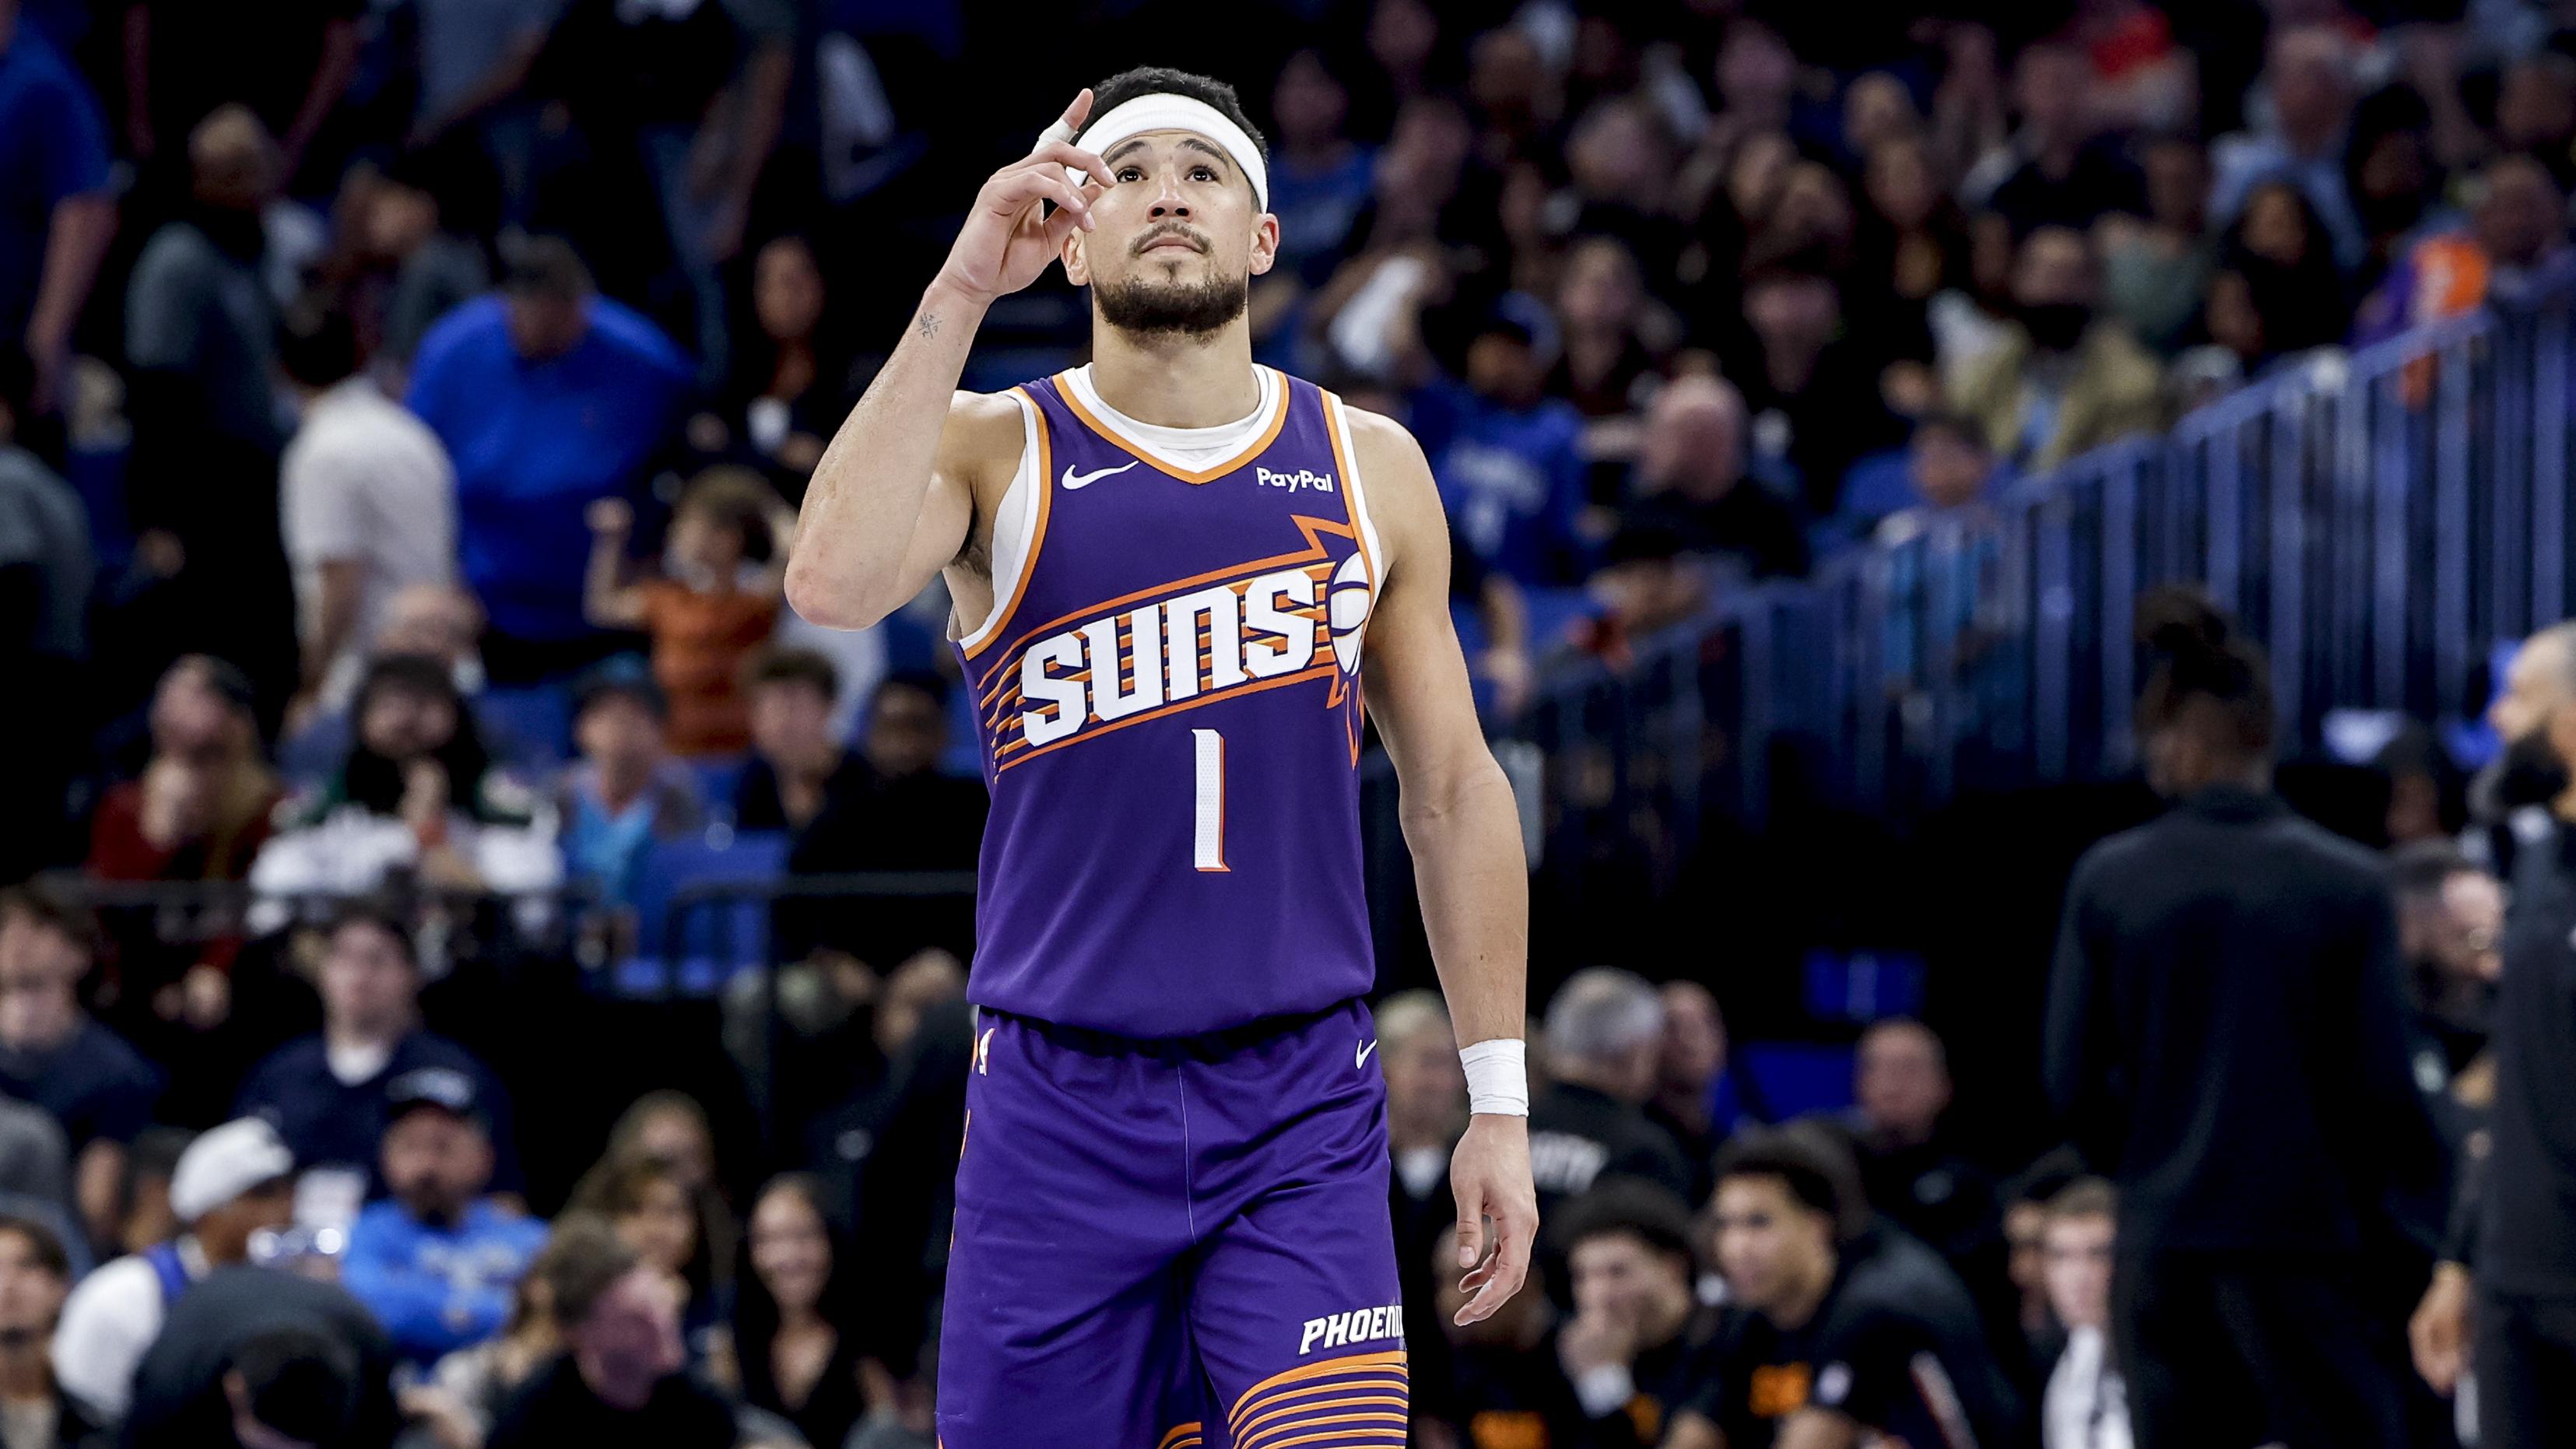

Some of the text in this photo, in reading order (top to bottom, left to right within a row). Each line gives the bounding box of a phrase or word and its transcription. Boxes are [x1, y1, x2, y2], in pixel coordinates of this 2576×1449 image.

[1256, 466, 1334, 493] PayPal
[1021, 570, 1316, 747] SUNS
[1191, 728, 1231, 872] 1
